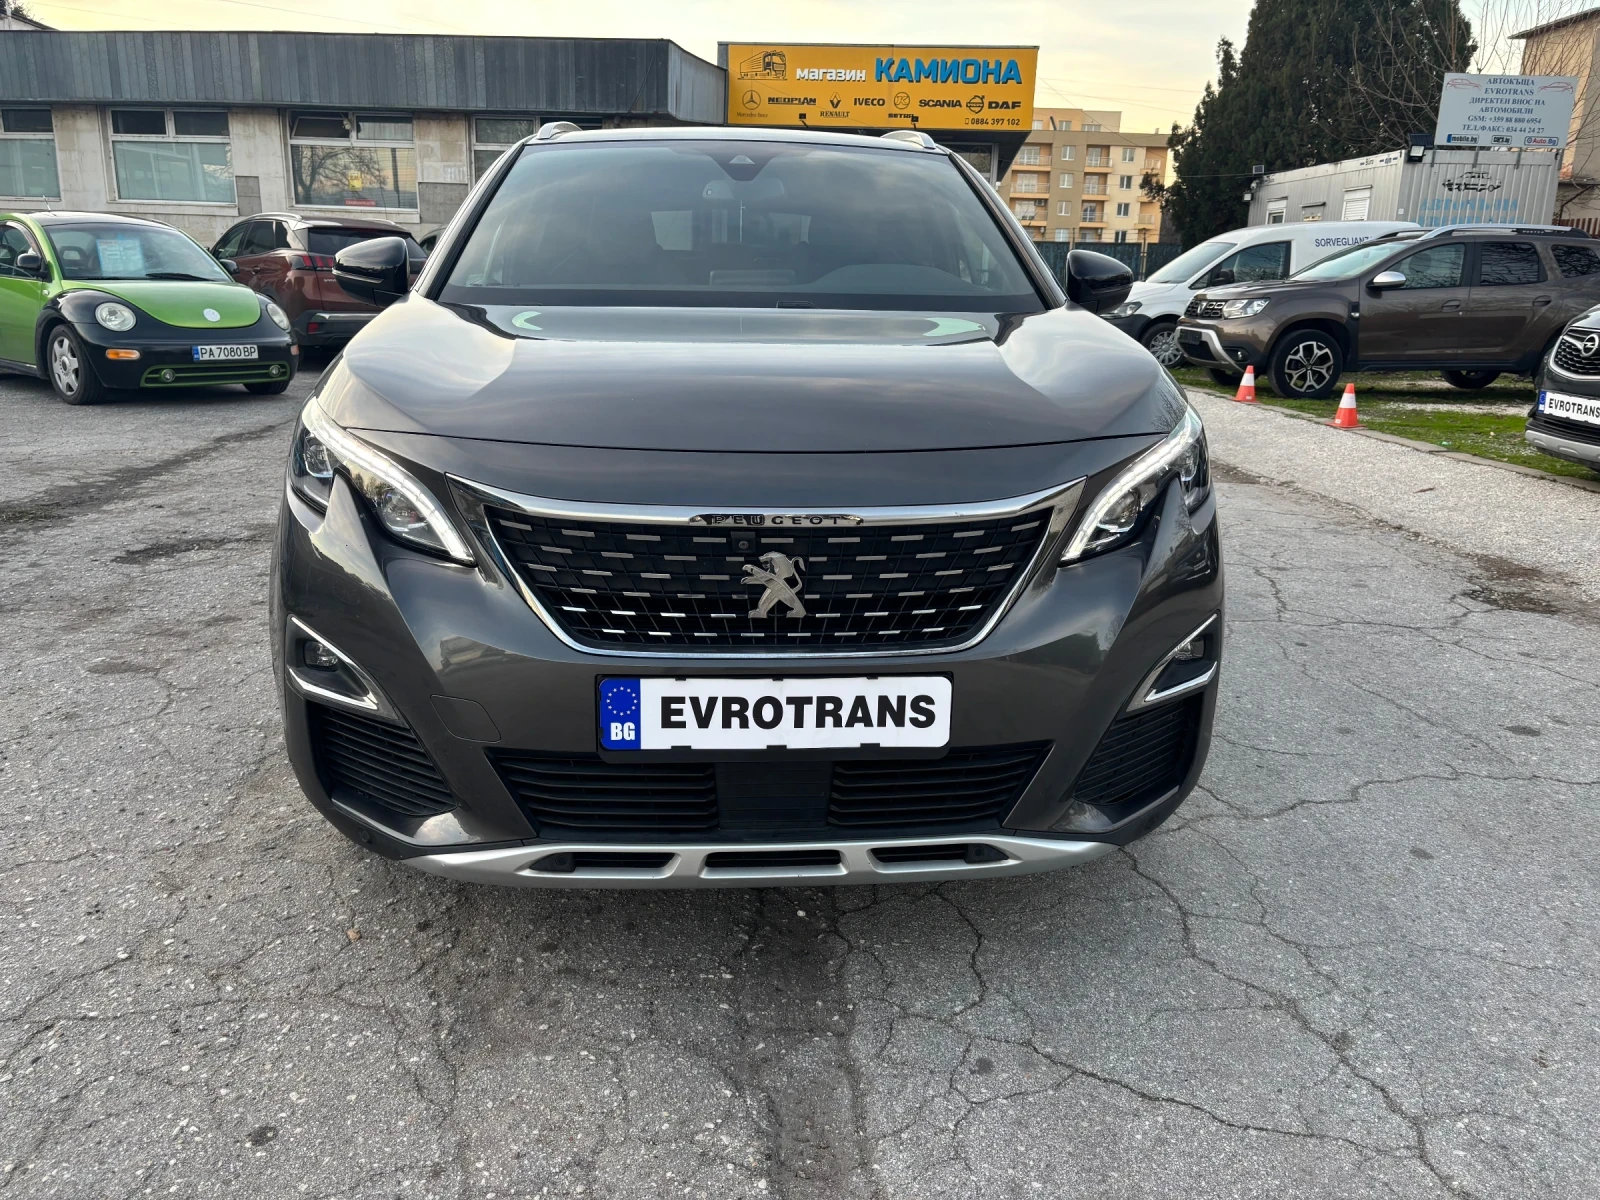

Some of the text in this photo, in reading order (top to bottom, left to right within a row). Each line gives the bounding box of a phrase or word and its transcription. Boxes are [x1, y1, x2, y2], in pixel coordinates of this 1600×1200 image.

[796, 57, 1022, 84] магазин КАМИОНА
[1486, 77, 1535, 86] АВТОКЪЩА
[1484, 87, 1535, 96] EVROTRANS
[767, 96, 816, 106] NEOPLAN
[853, 97, 886, 107] IVECO
[918, 99, 962, 108] SCANIA
[987, 101, 1021, 110] DAF
[1469, 97, 1546, 106] ДИРЕКТЕН ВНОС НА
[820, 110, 851, 118] RENAULT
[1479, 106, 1534, 115] АВТОМОБИЛИ
[990, 118, 1005, 126] 397
[1007, 118, 1020, 126] 102
[1462, 124, 1505, 132] ТЕЛ/ФАКС:
[1452, 135, 1478, 143] mobile.bg
[1315, 236, 1372, 247] SORVEGLIAN
[1548, 397, 1600, 418] EVROTRANS
[712, 515, 840, 525] PEUGEOT
[610, 694, 936, 741] BG EVROTRANS
